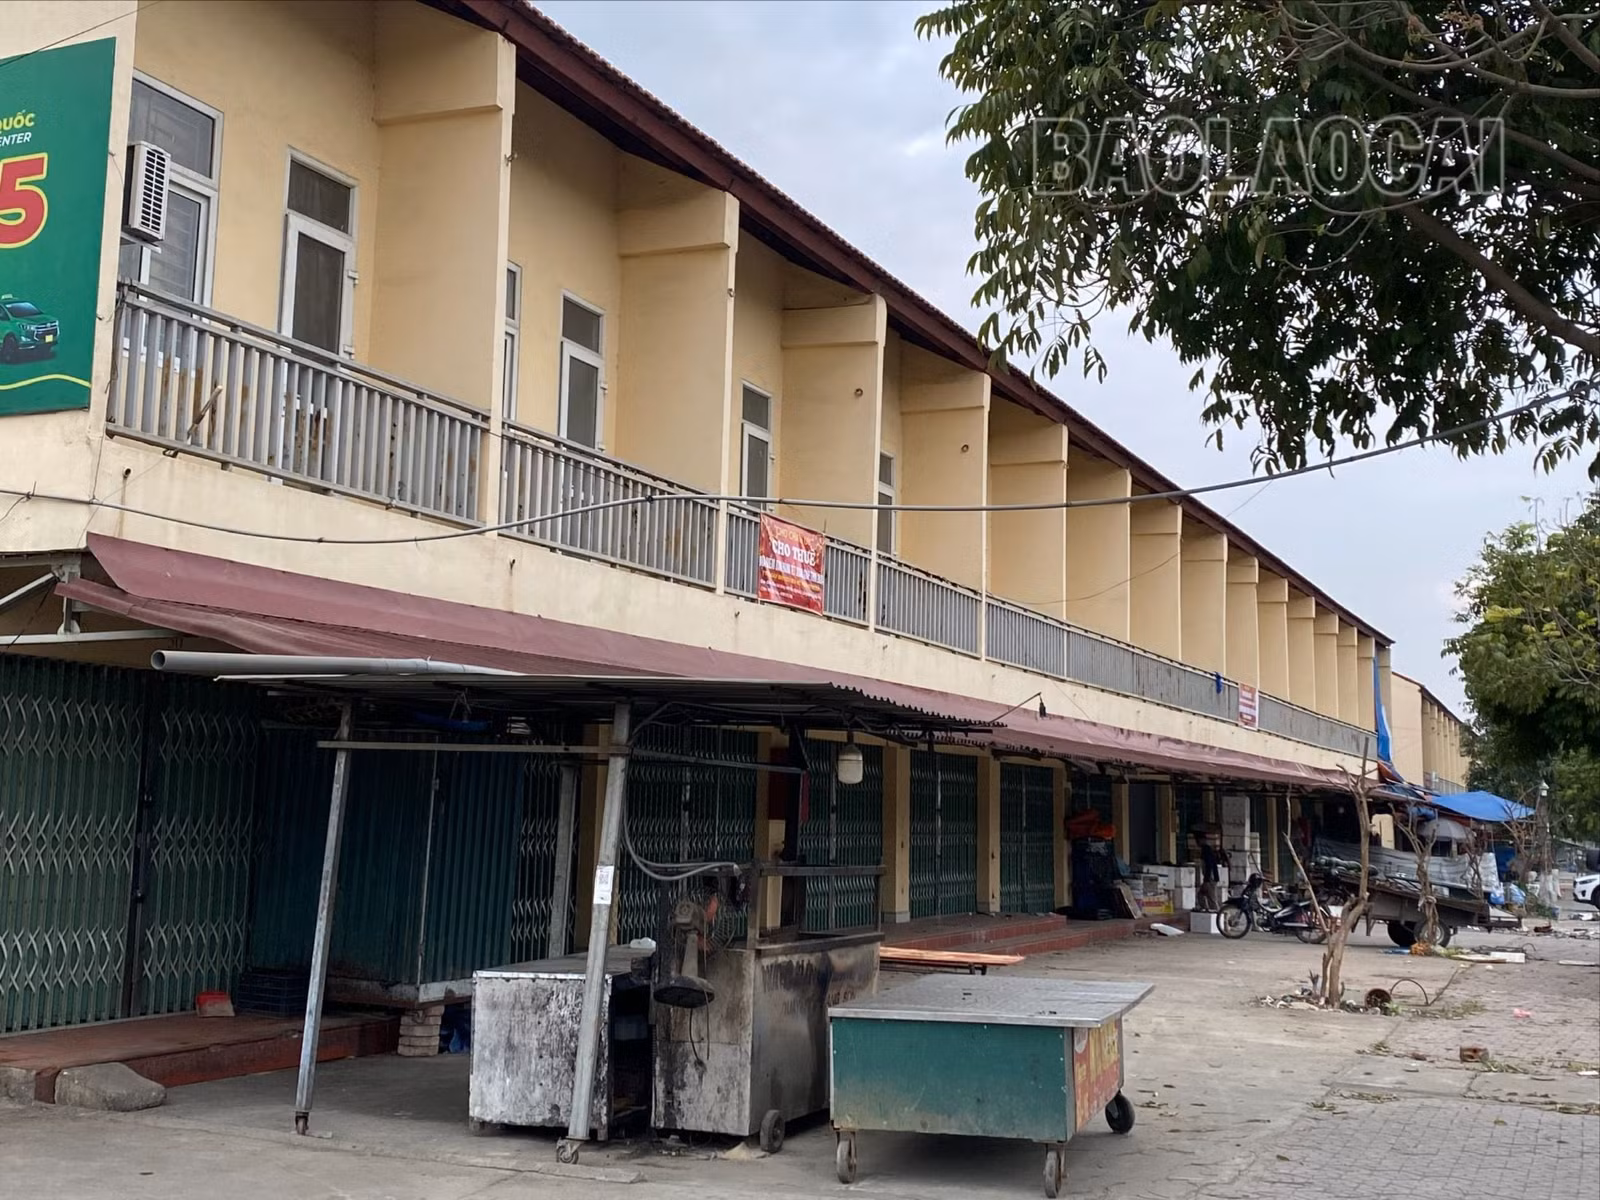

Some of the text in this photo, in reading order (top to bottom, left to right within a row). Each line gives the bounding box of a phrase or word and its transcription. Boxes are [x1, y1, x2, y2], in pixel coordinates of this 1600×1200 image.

[0, 109, 36, 131] UỐC
[0, 152, 48, 249] 5
[771, 539, 791, 558] CHO
